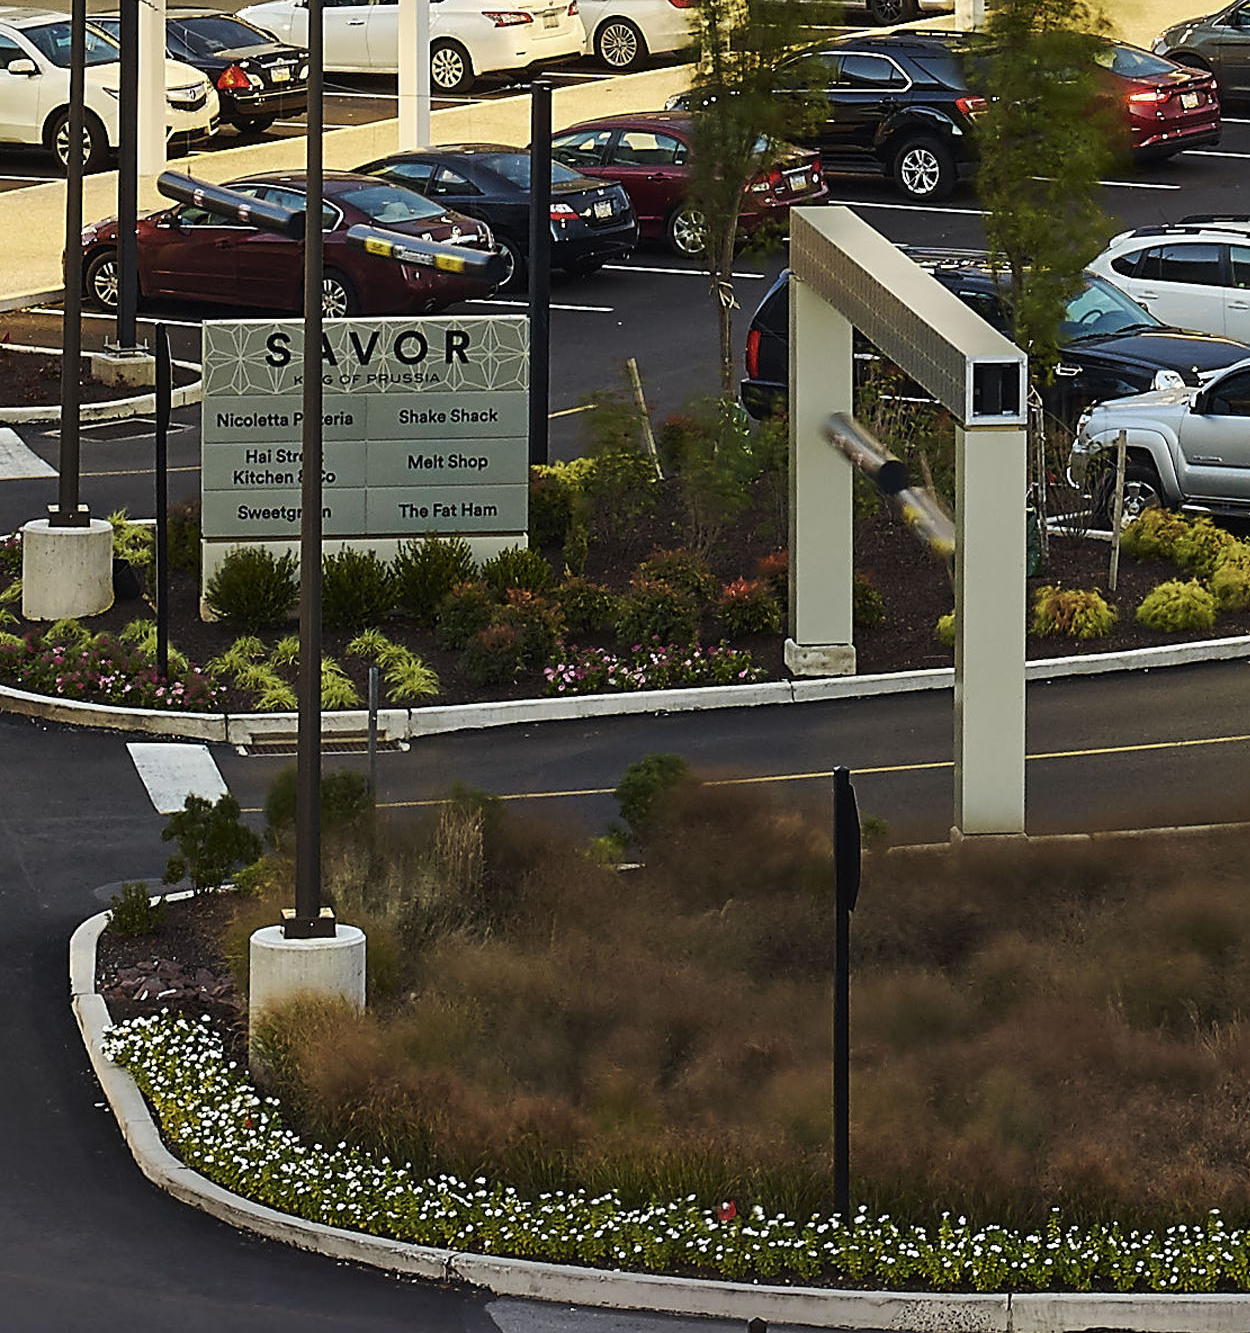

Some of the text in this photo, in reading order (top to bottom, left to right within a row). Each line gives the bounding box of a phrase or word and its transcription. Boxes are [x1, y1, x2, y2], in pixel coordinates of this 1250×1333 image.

[294, 372, 440, 385] KG OF PRUSSIA
[216, 412, 289, 428] Nicoletta
[399, 408, 498, 424] Shake Shack
[246, 449, 272, 464] Hai
[408, 453, 488, 471] Melt Shop
[233, 469, 294, 485] Kitchen
[238, 505, 332, 523] Sweetgrn
[398, 502, 498, 519] The Fat Ham
